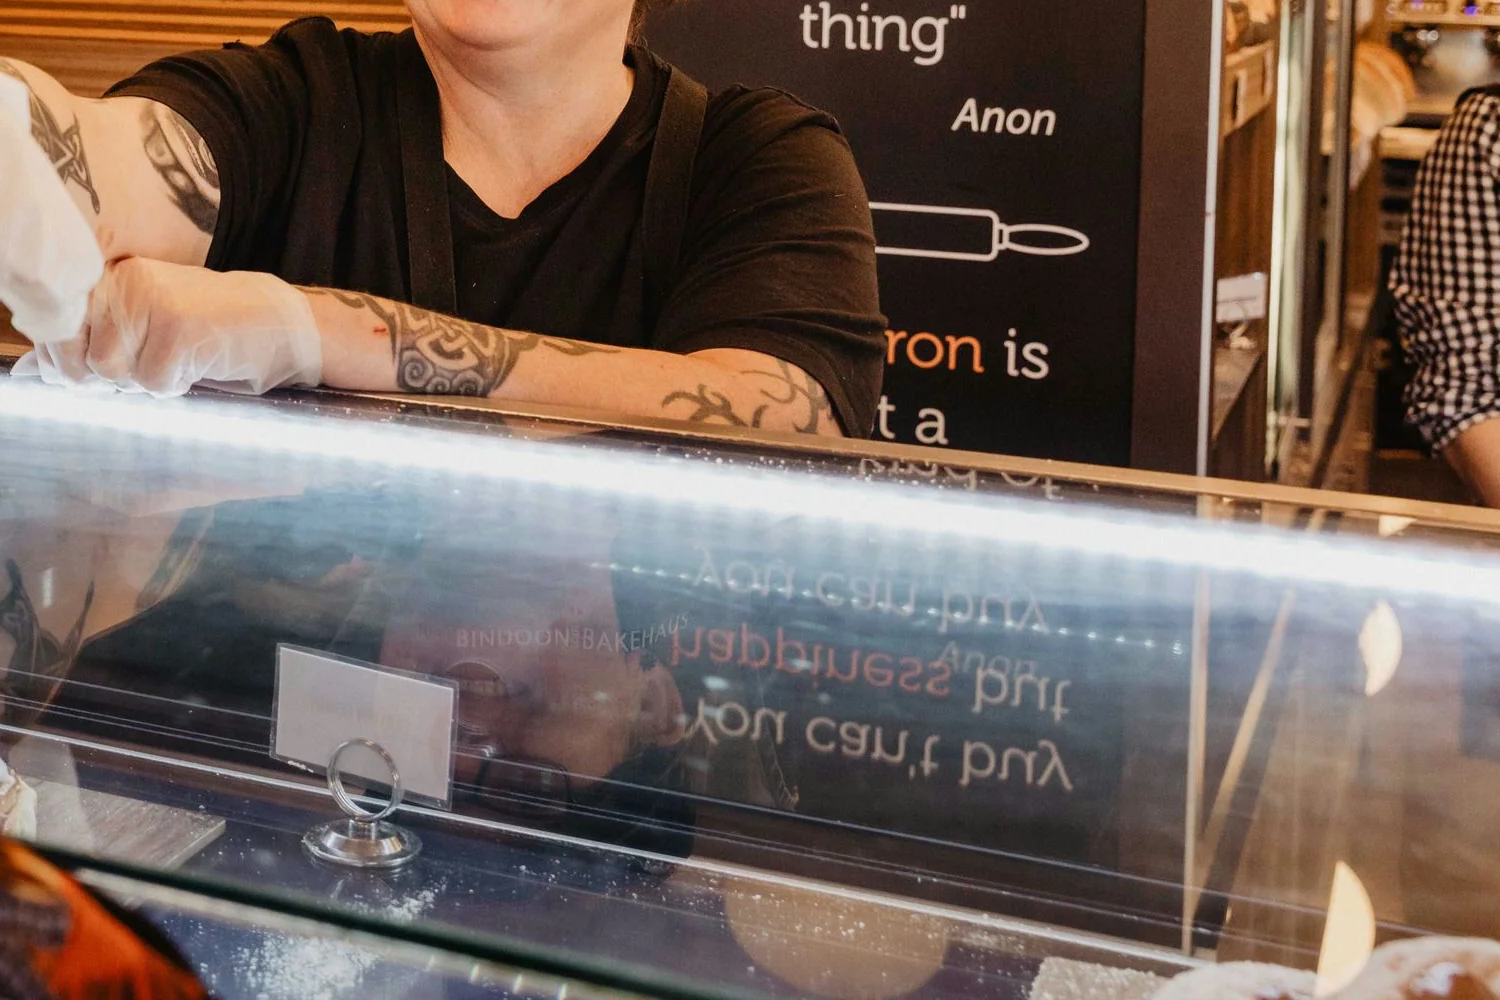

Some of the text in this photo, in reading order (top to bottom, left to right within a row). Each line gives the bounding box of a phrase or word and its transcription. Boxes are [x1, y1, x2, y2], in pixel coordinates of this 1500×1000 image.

[799, 1, 967, 67] thing"
[951, 97, 1058, 137] Anon
[884, 327, 1049, 380] ron is
[915, 407, 949, 446] a
[456, 627, 570, 648] BINDOON
[582, 610, 691, 653] BAKEHAUS
